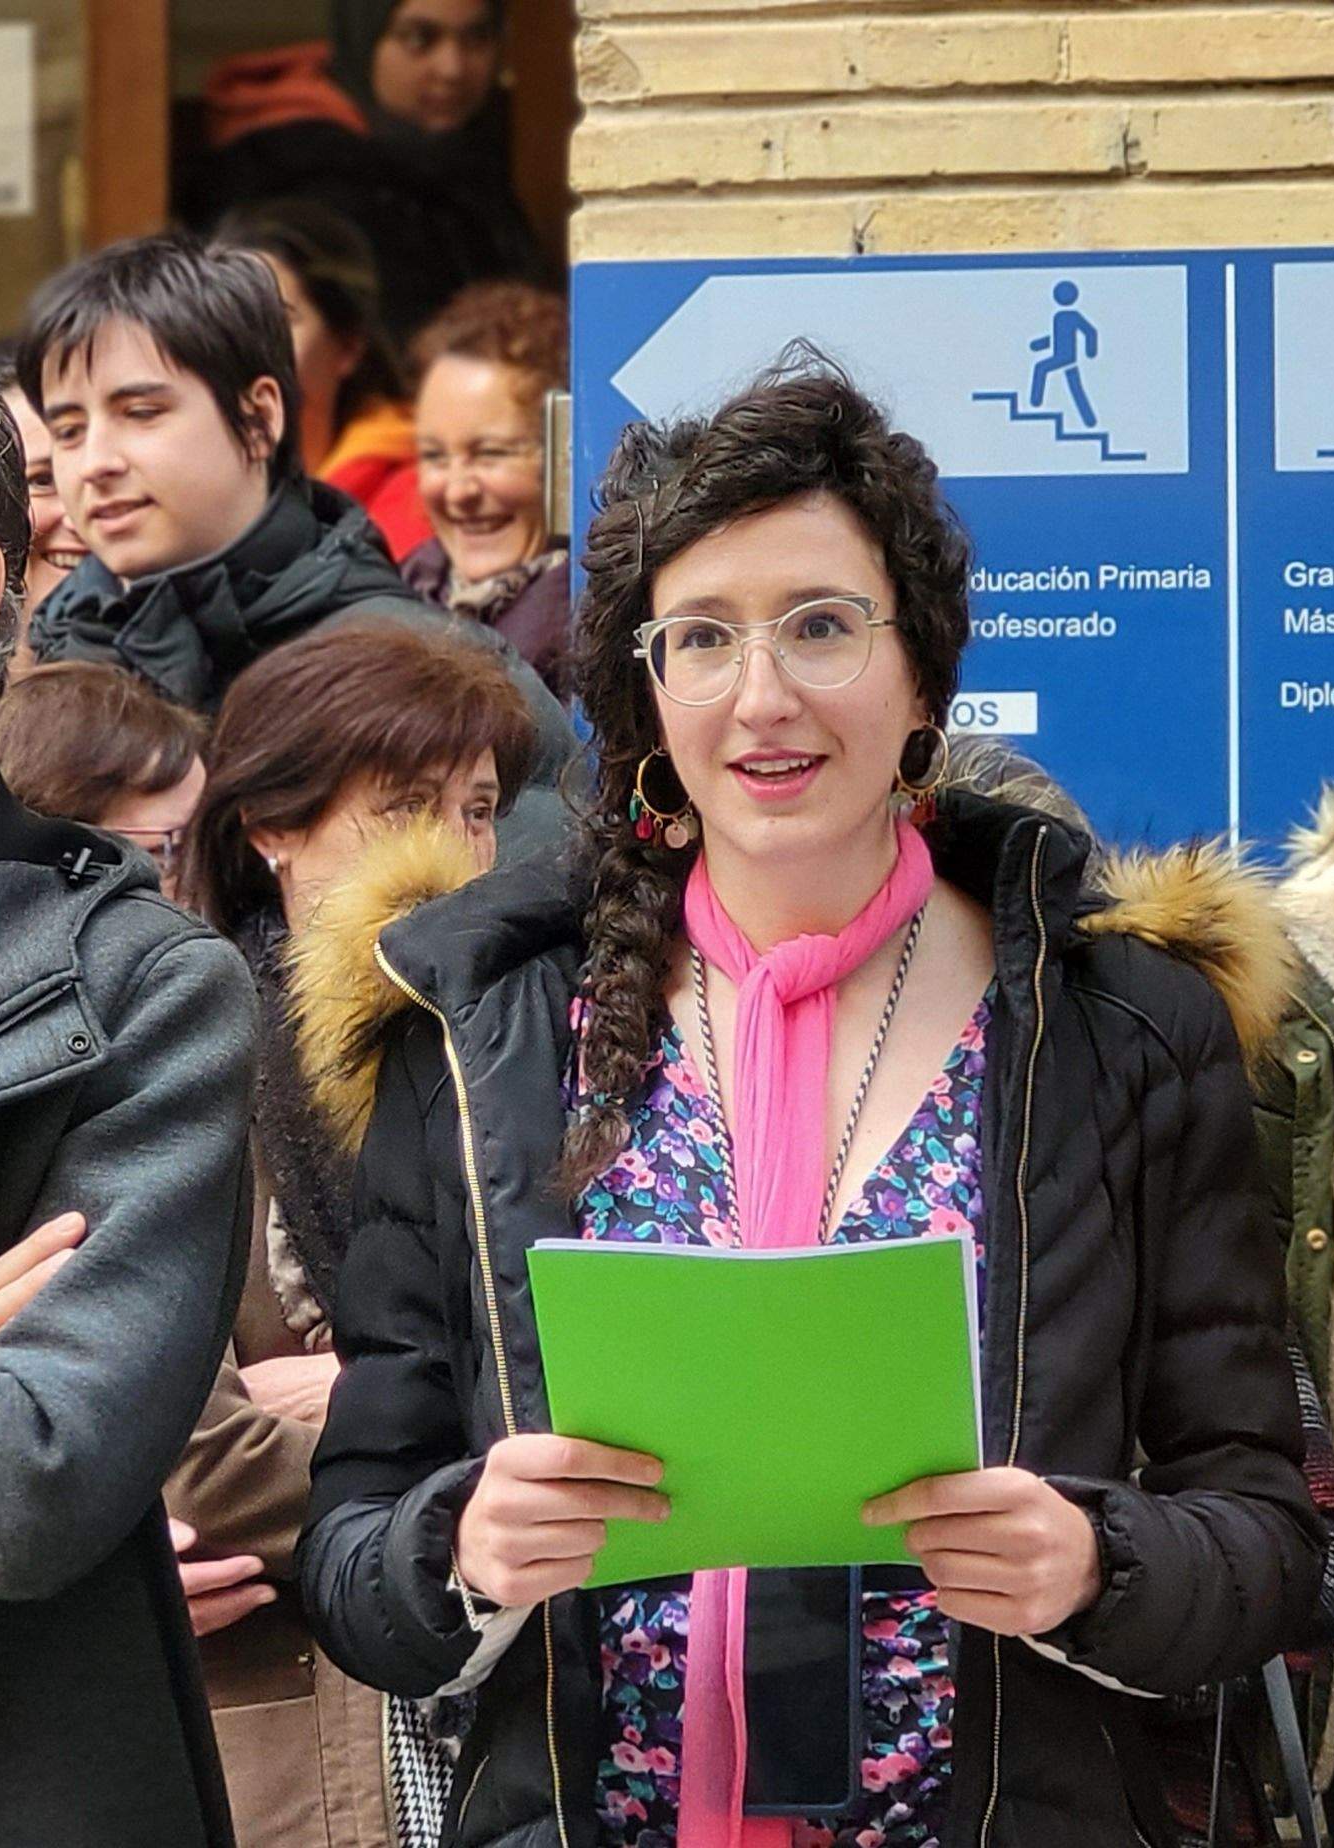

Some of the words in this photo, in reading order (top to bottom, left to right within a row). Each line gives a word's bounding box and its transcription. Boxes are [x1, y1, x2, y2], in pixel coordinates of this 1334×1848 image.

[969, 566, 1090, 593] ducación
[1098, 563, 1212, 591] Primaria
[970, 611, 1117, 639] rofesorado
